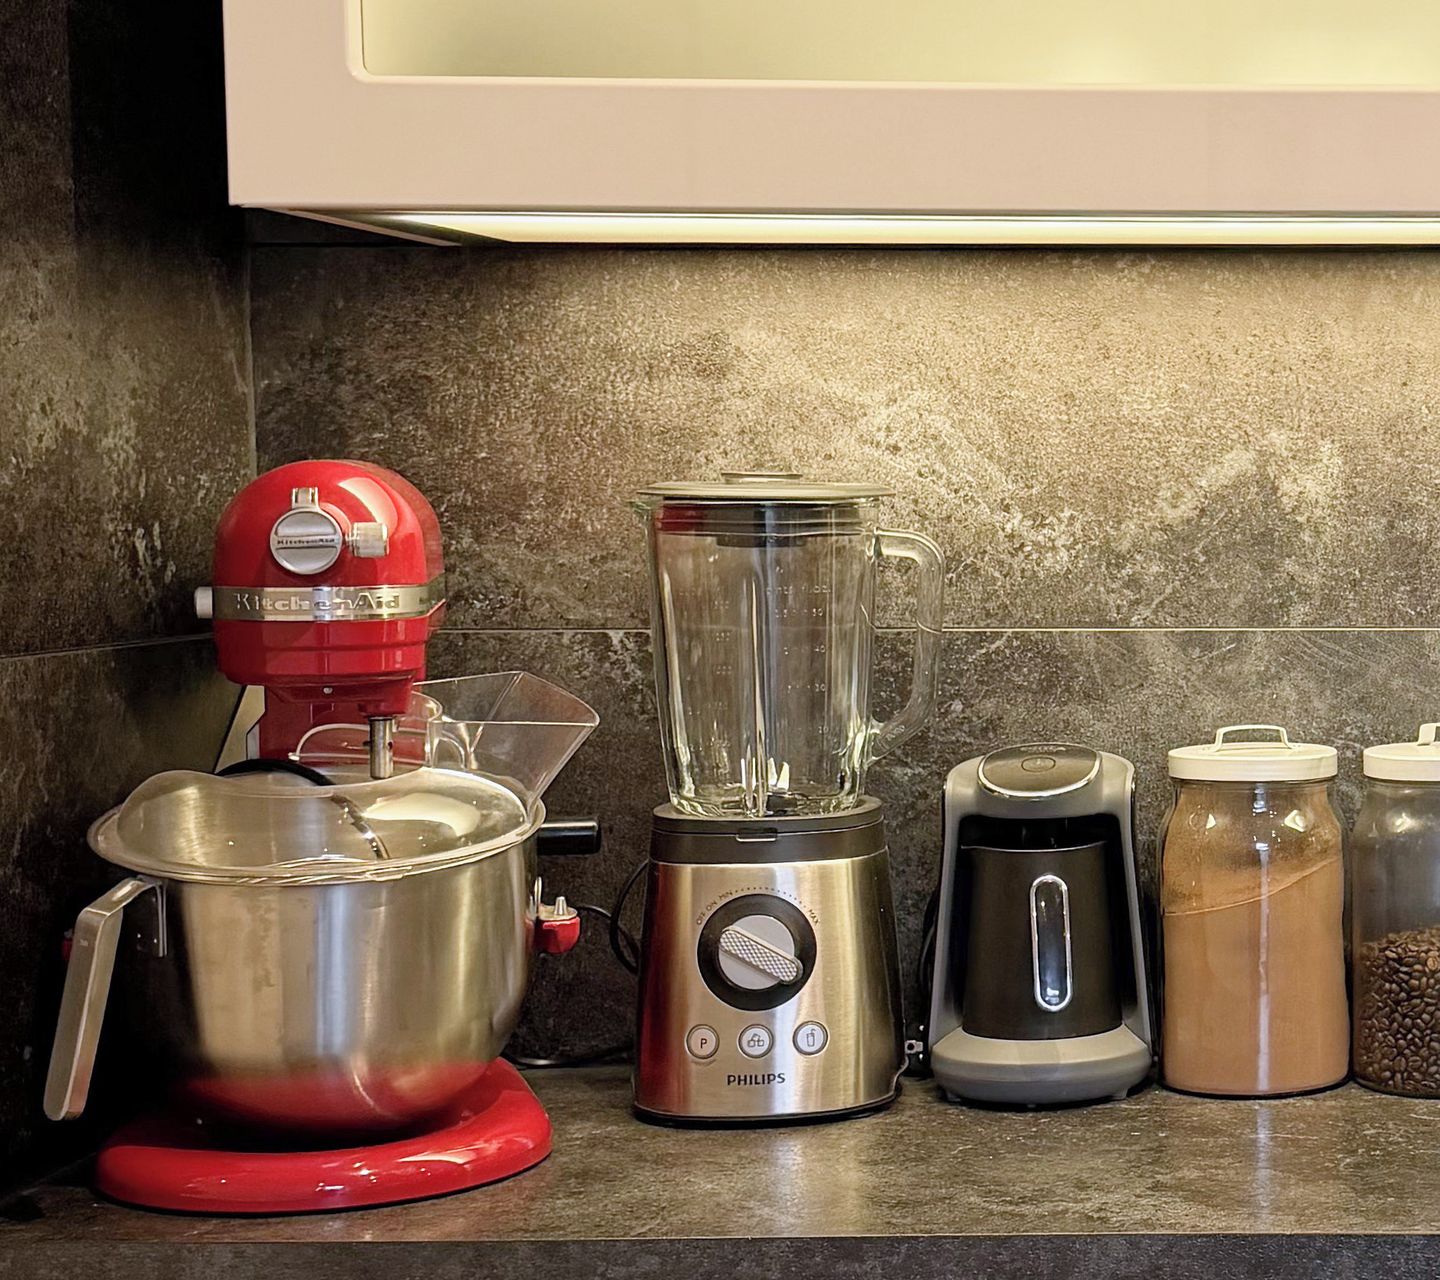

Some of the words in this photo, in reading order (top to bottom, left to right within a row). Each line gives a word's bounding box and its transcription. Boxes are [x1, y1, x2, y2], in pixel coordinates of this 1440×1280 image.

[234, 591, 401, 611] KitchenAid
[700, 1037, 708, 1050] P
[726, 1073, 786, 1087] PHILIPS
